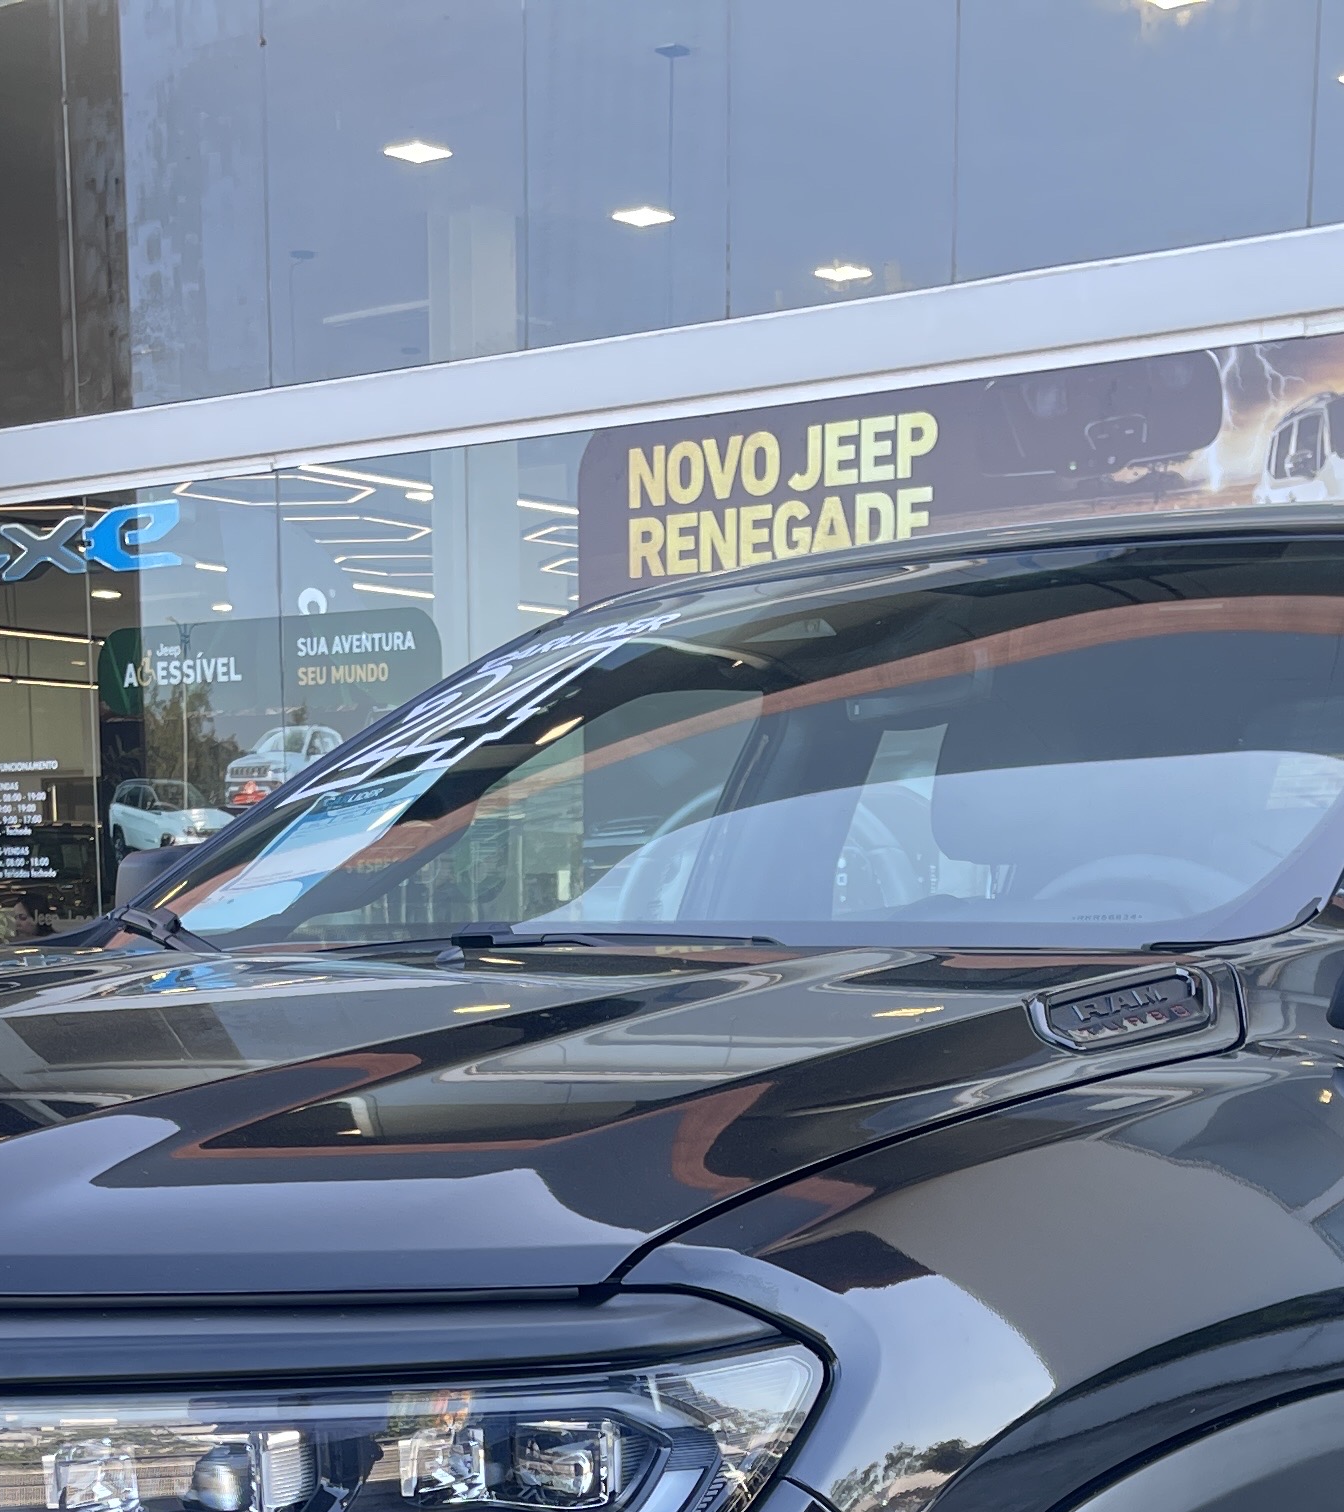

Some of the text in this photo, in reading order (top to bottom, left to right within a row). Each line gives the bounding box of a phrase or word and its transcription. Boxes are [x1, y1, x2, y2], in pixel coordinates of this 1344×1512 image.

[628, 411, 938, 509] NOVO JEEP
[628, 486, 933, 579] RENEGADE
[156, 642, 181, 658] Jeep
[296, 630, 417, 657] SUA AVENTURA
[297, 662, 389, 686] SEU MUNDO
[1071, 986, 1168, 1022] RAM
